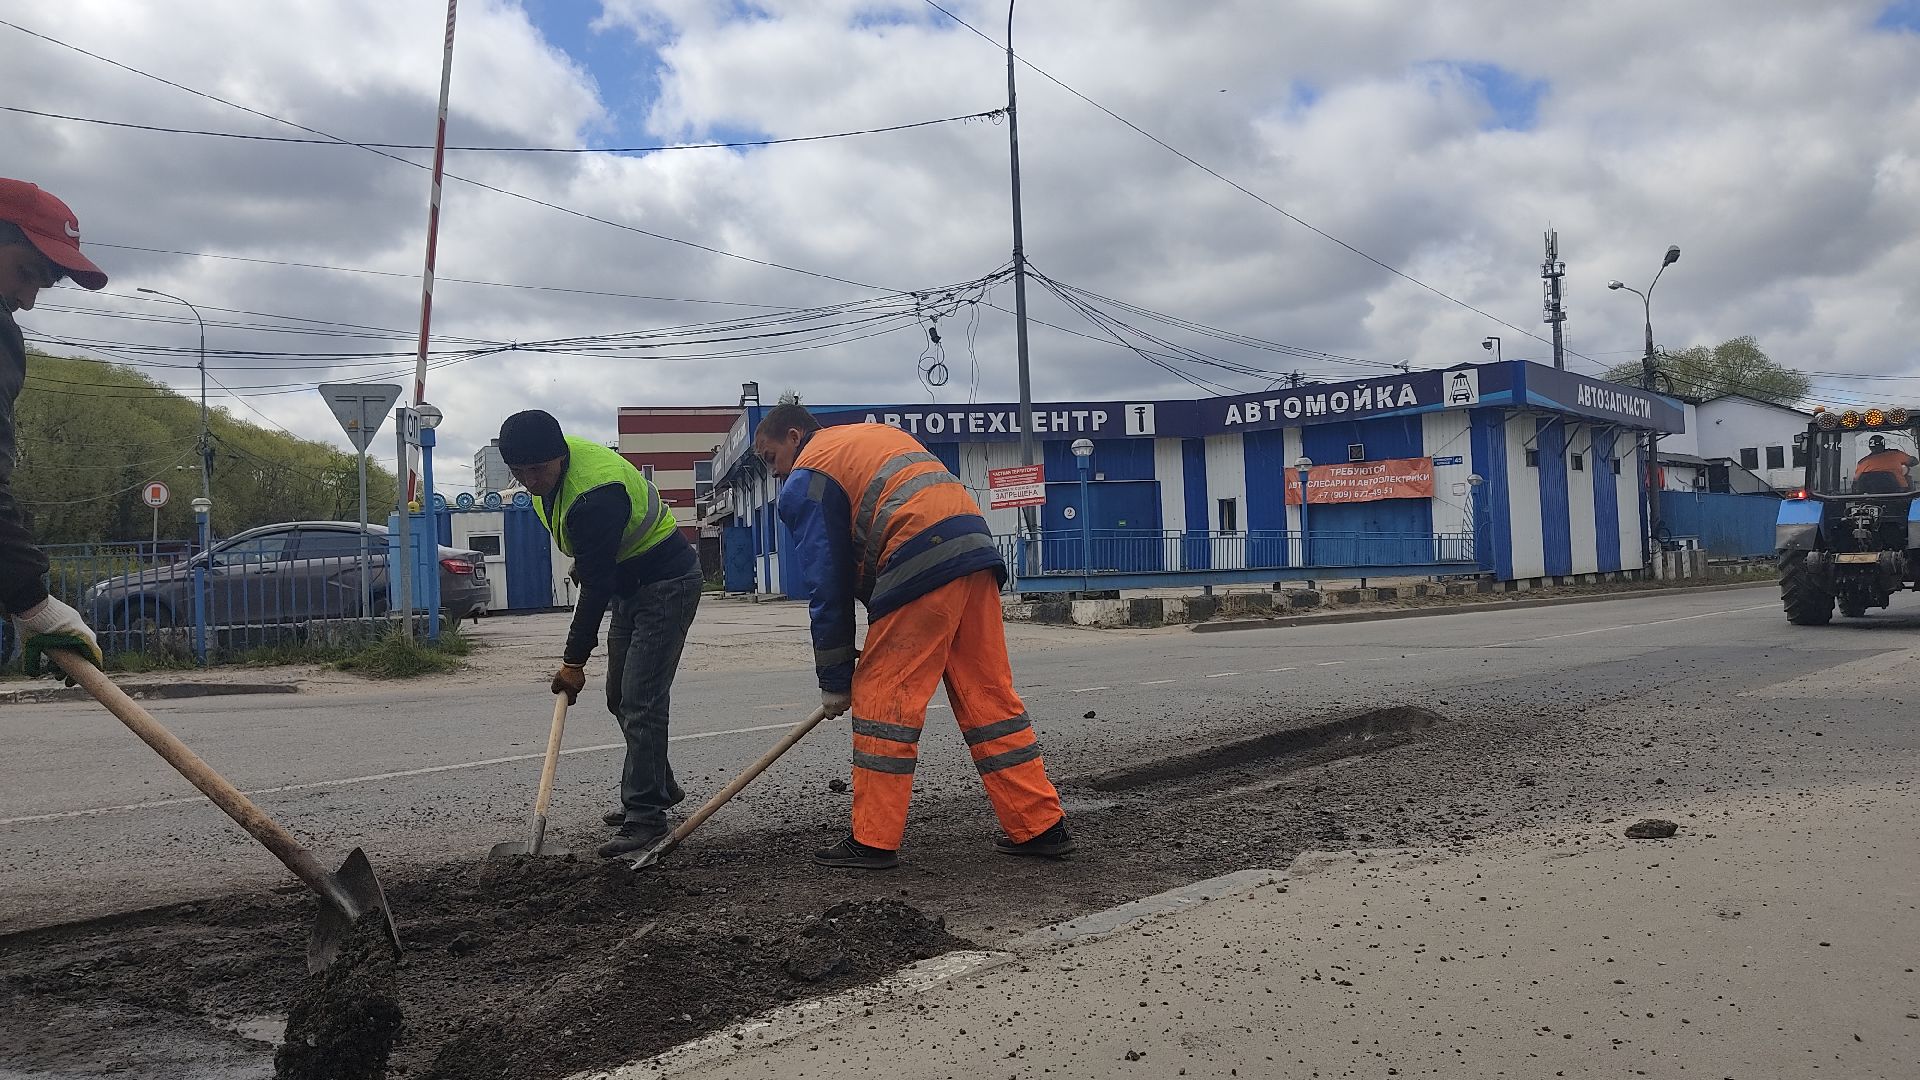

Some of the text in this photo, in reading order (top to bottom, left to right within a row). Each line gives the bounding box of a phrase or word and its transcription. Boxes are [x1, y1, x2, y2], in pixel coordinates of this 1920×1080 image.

[1225, 384, 1418, 425] АВТОМОЙКА
[1577, 384, 1651, 419] АВТОЗАПЧАСТИ
[1330, 464, 1386, 477] ТРЕБУЮТСЯ
[1288, 473, 1430, 489] АВТСЛЕСАРИ И АВТОЭЛЕКТРИКИ
[995, 489, 1039, 500] ЗАПРЕЩЕНА
[1319, 491, 1329, 499] +7
[1331, 490, 1352, 500] (909)
[1067, 508, 1073, 517] 2
